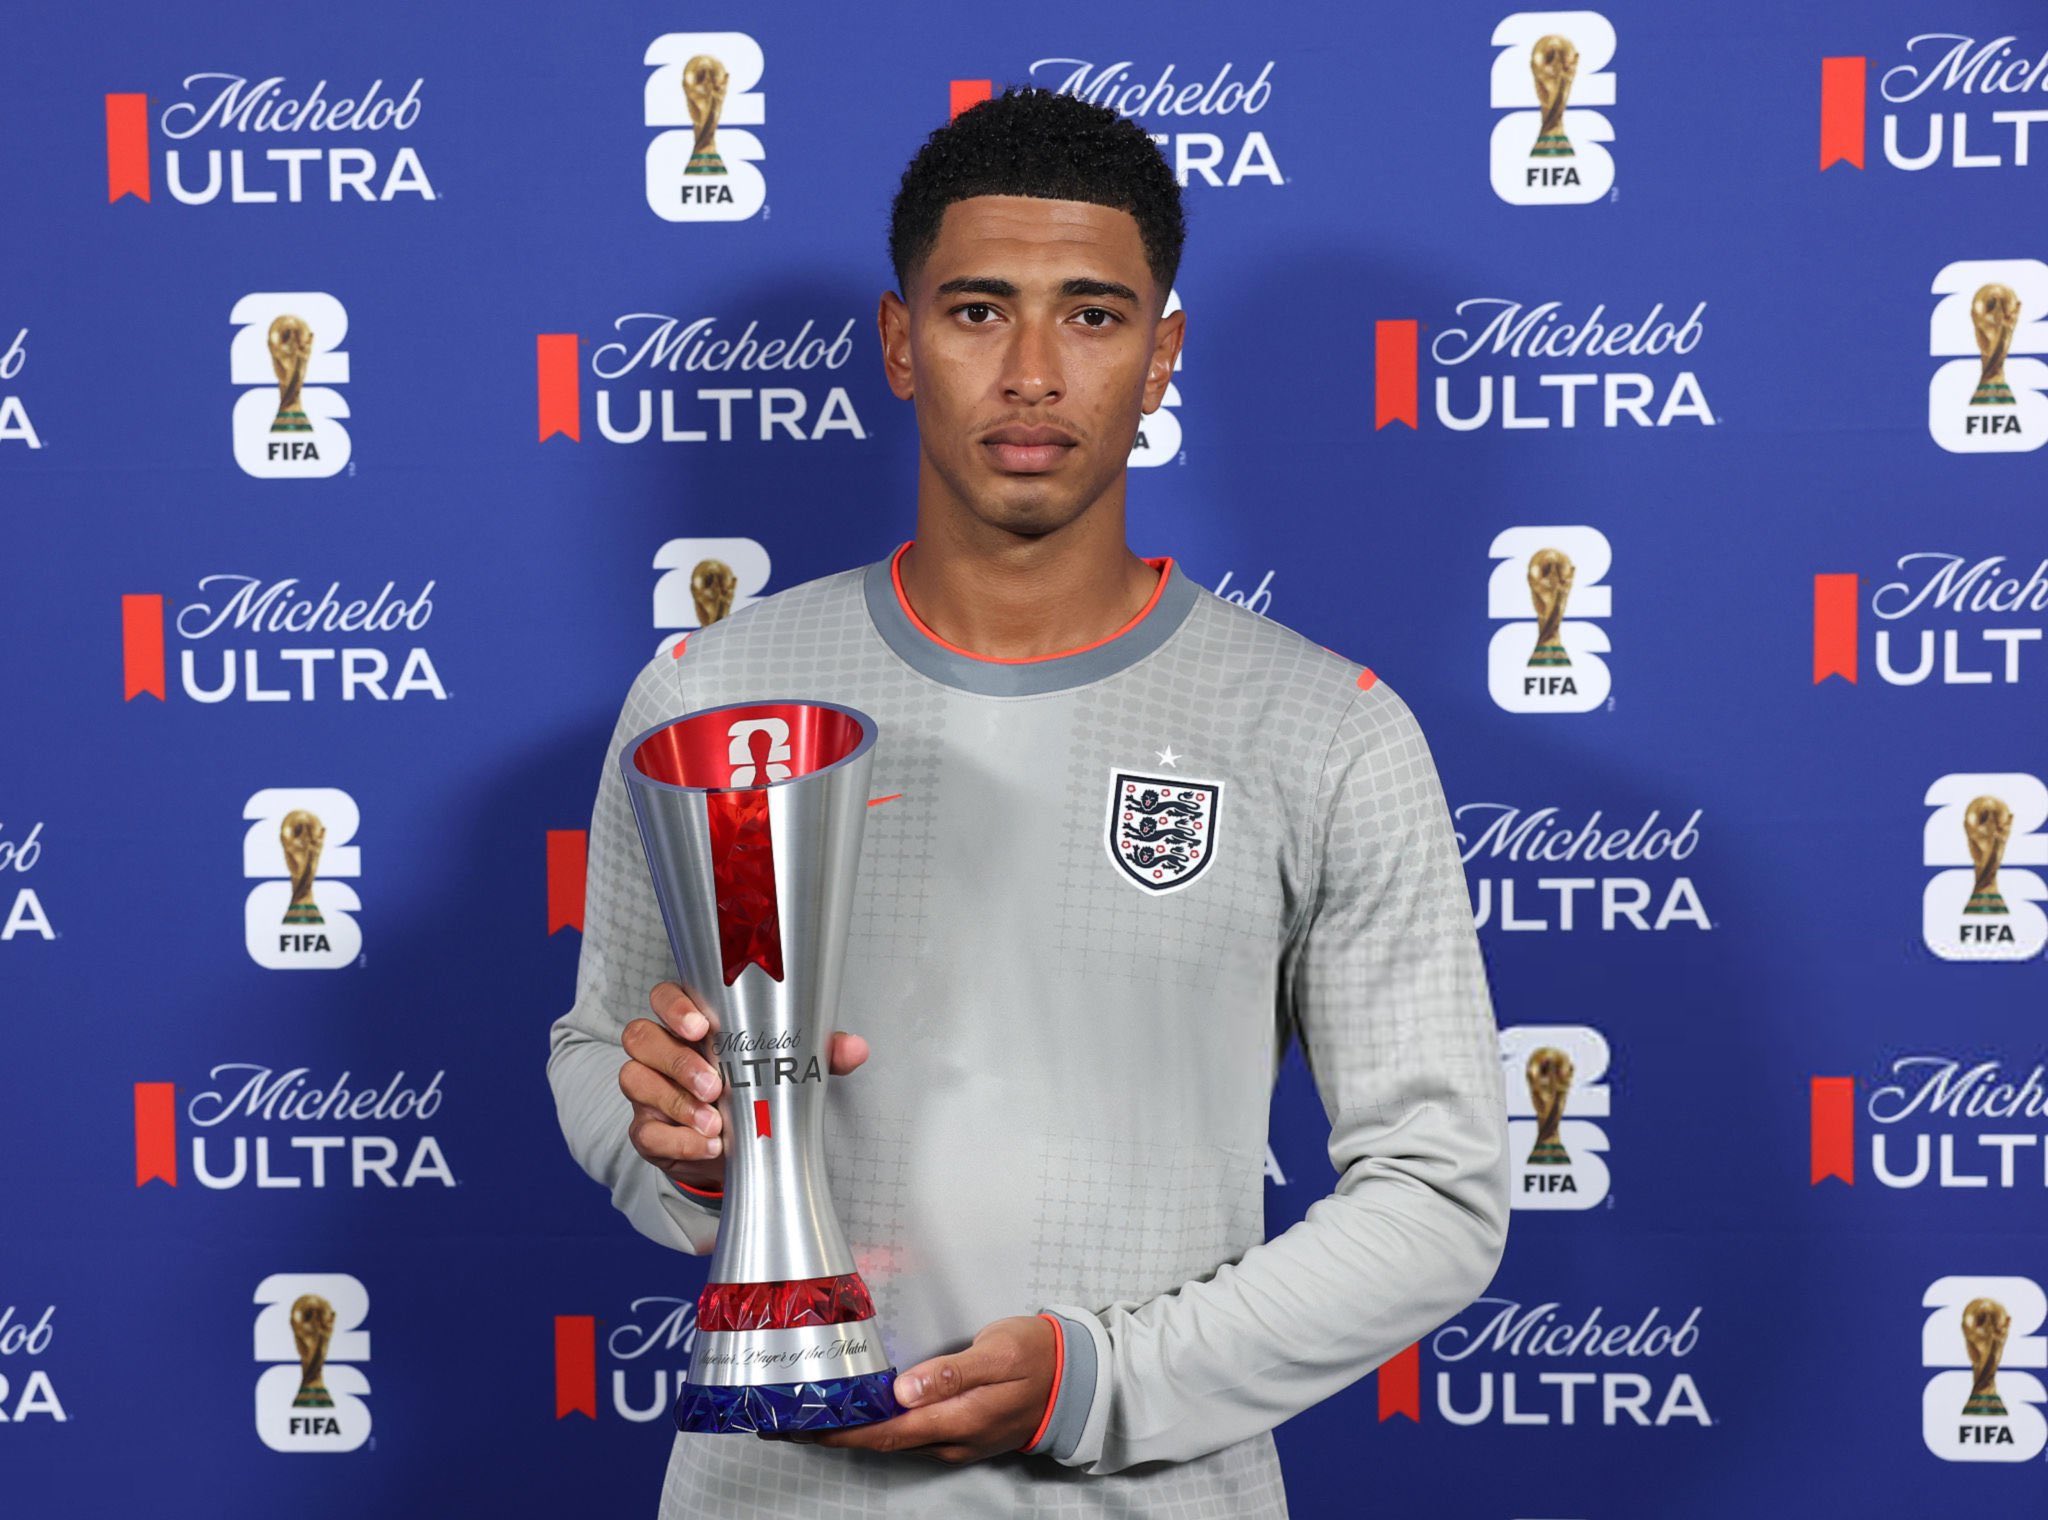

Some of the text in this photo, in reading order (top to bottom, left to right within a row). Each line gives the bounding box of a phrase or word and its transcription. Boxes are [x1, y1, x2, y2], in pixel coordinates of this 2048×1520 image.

[1880, 33, 2048, 104] Mich
[160, 72, 424, 140] Michelob
[1883, 109, 2048, 171] ULT
[165, 147, 437, 206] ULTRA
[682, 185, 733, 204] FIFA
[1527, 167, 1580, 187] FIFA
[591, 312, 856, 380] Michelob
[1431, 297, 1708, 366] Michelob
[595, 387, 868, 445] ULTRA
[1435, 371, 1716, 432] ULTRA
[1966, 415, 2021, 434] FIFA
[268, 442, 319, 461] FIFA
[176, 574, 436, 640] Michelob
[1871, 552, 2048, 620] Mich
[181, 647, 448, 704] ULTRA
[1875, 628, 2043, 686] ULT
[1524, 677, 1577, 695] FIFA
[280, 934, 331, 952] FIFA
[1960, 925, 2014, 942] FIFA
[711, 1029, 802, 1056] Michelob
[187, 1062, 445, 1128] Michelob
[1868, 1056, 2048, 1124] Mich
[192, 1136, 456, 1190] ULTRA
[1524, 1174, 1577, 1193] FIFA
[1872, 1133, 2048, 1189] ULT
[738, 1346, 787, 1369] Player
[780, 1348, 805, 1369] of
[804, 1344, 825, 1361] the
[826, 1337, 868, 1361] Match
[1432, 1296, 1702, 1363] Michelob
[289, 1417, 341, 1435] FIFA
[1436, 1371, 1713, 1427] ULTRA
[1959, 1425, 2014, 1444] FIFA
